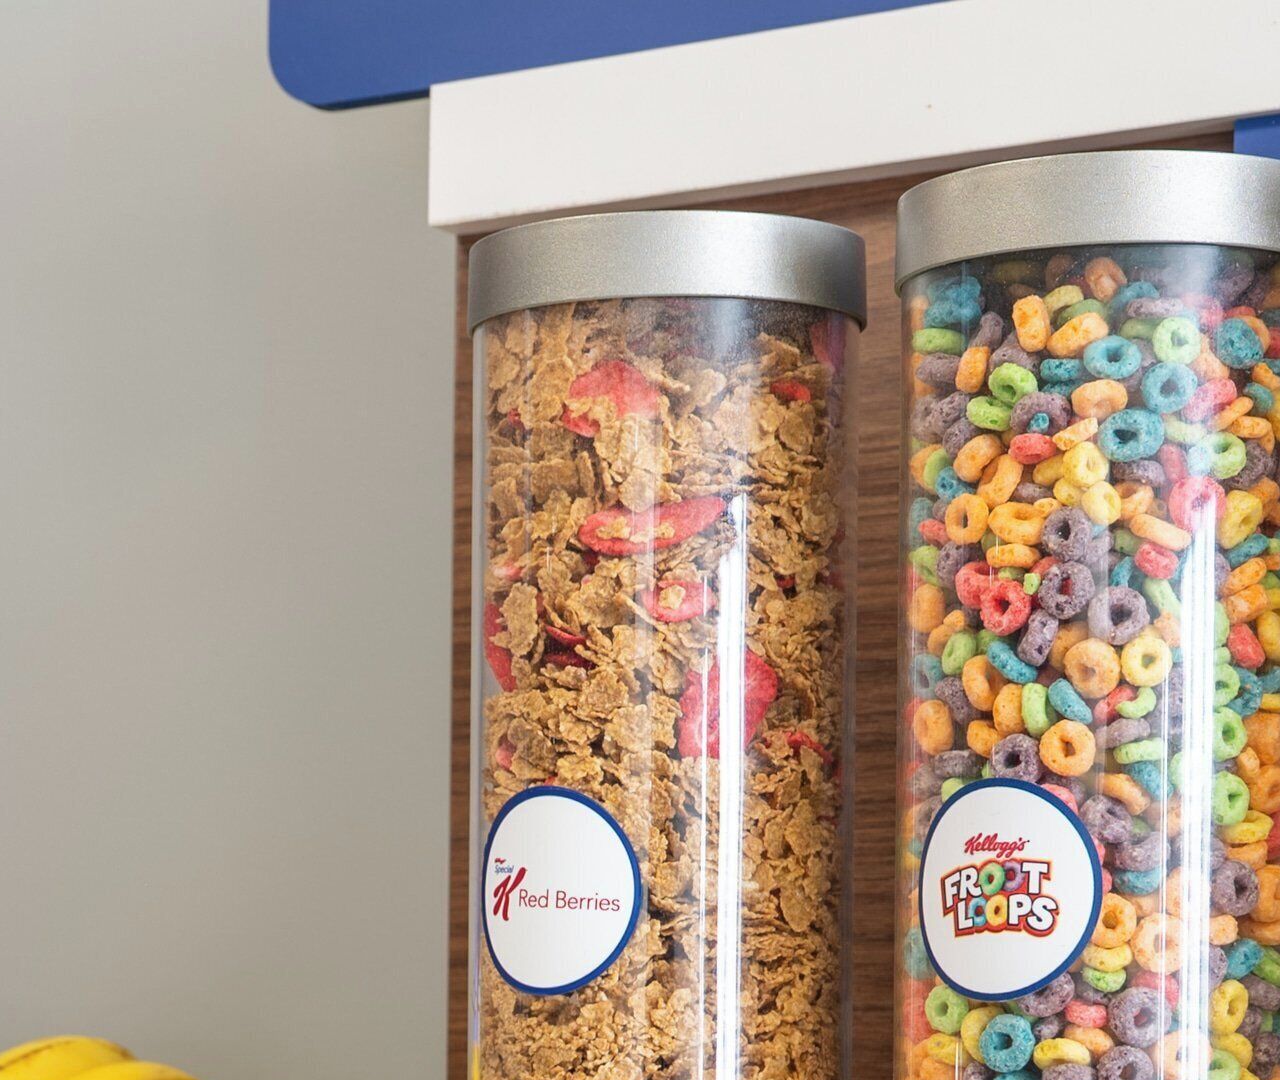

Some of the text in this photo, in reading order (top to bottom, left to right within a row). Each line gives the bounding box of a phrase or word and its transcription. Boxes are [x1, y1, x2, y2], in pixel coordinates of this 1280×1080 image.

[964, 832, 1028, 858] Kellogg's
[493, 867, 620, 921] K Red Berries
[943, 859, 1049, 909] FROOT
[957, 893, 1059, 932] LOOPS
